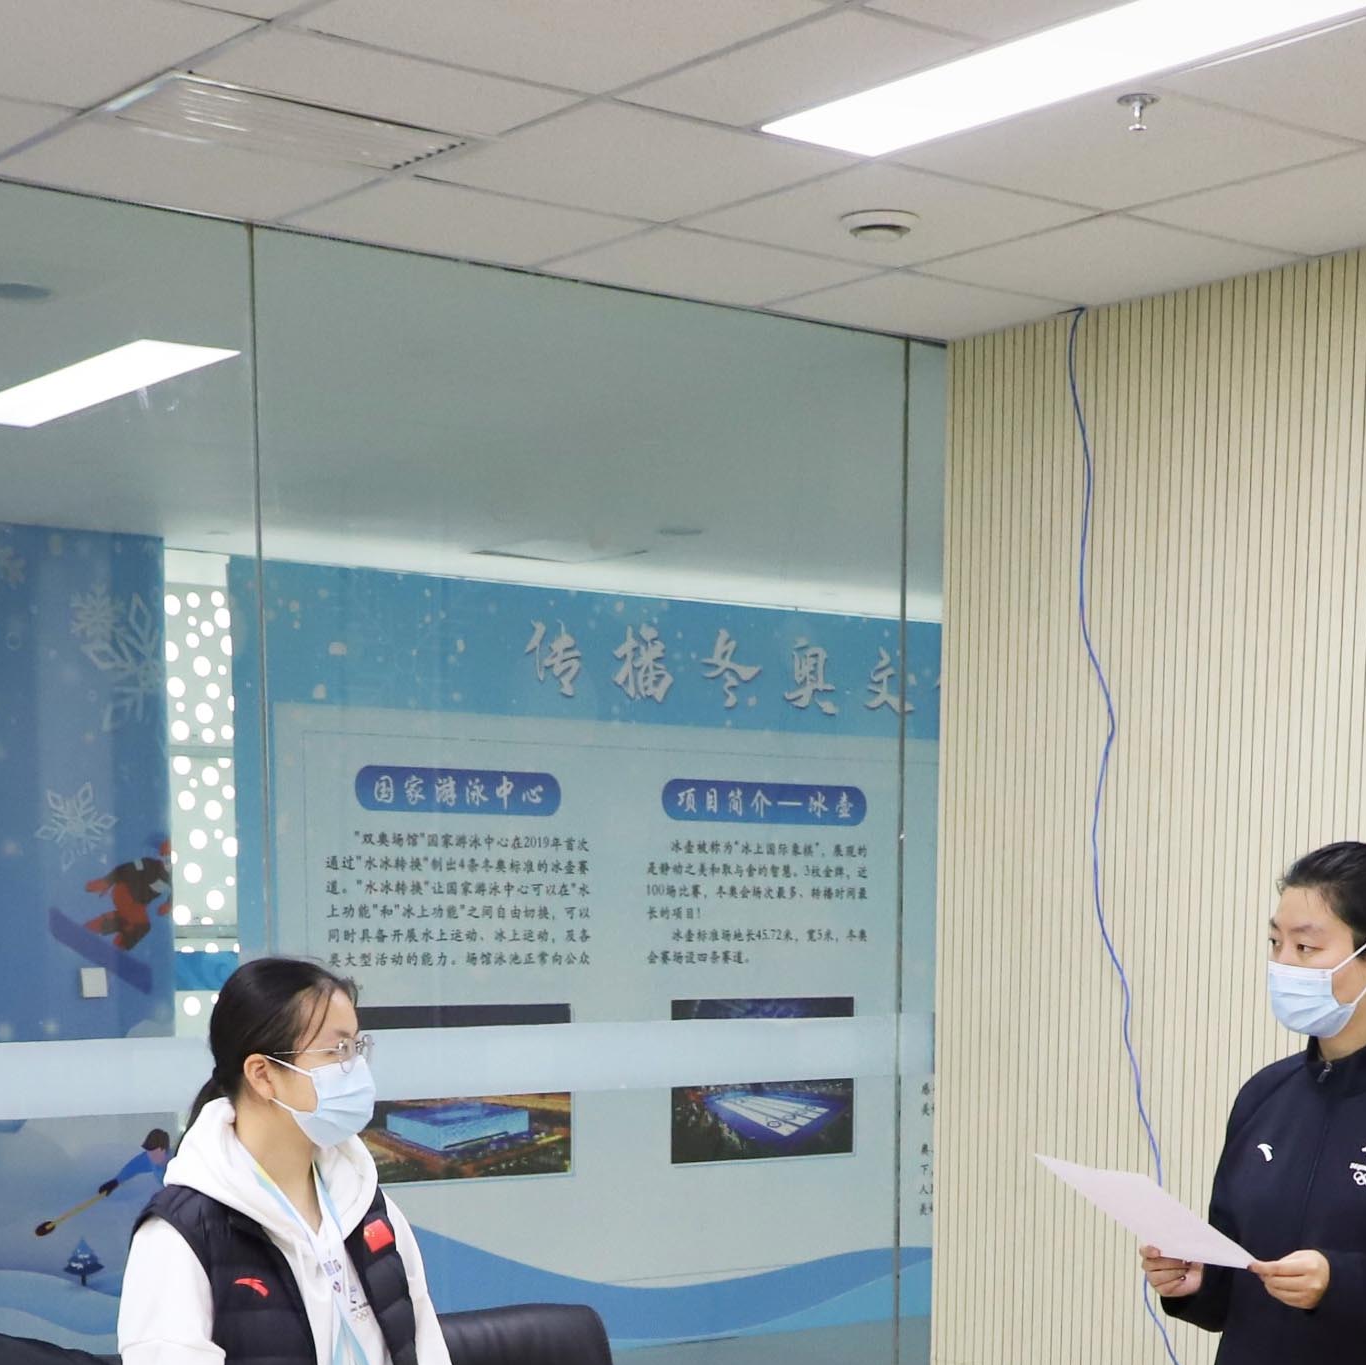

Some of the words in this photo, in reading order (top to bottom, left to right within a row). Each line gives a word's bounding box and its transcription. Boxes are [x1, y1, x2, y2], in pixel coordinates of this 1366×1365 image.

[525, 615, 942, 716] 传播冬奥文
[374, 775, 545, 809] 国家游泳中心
